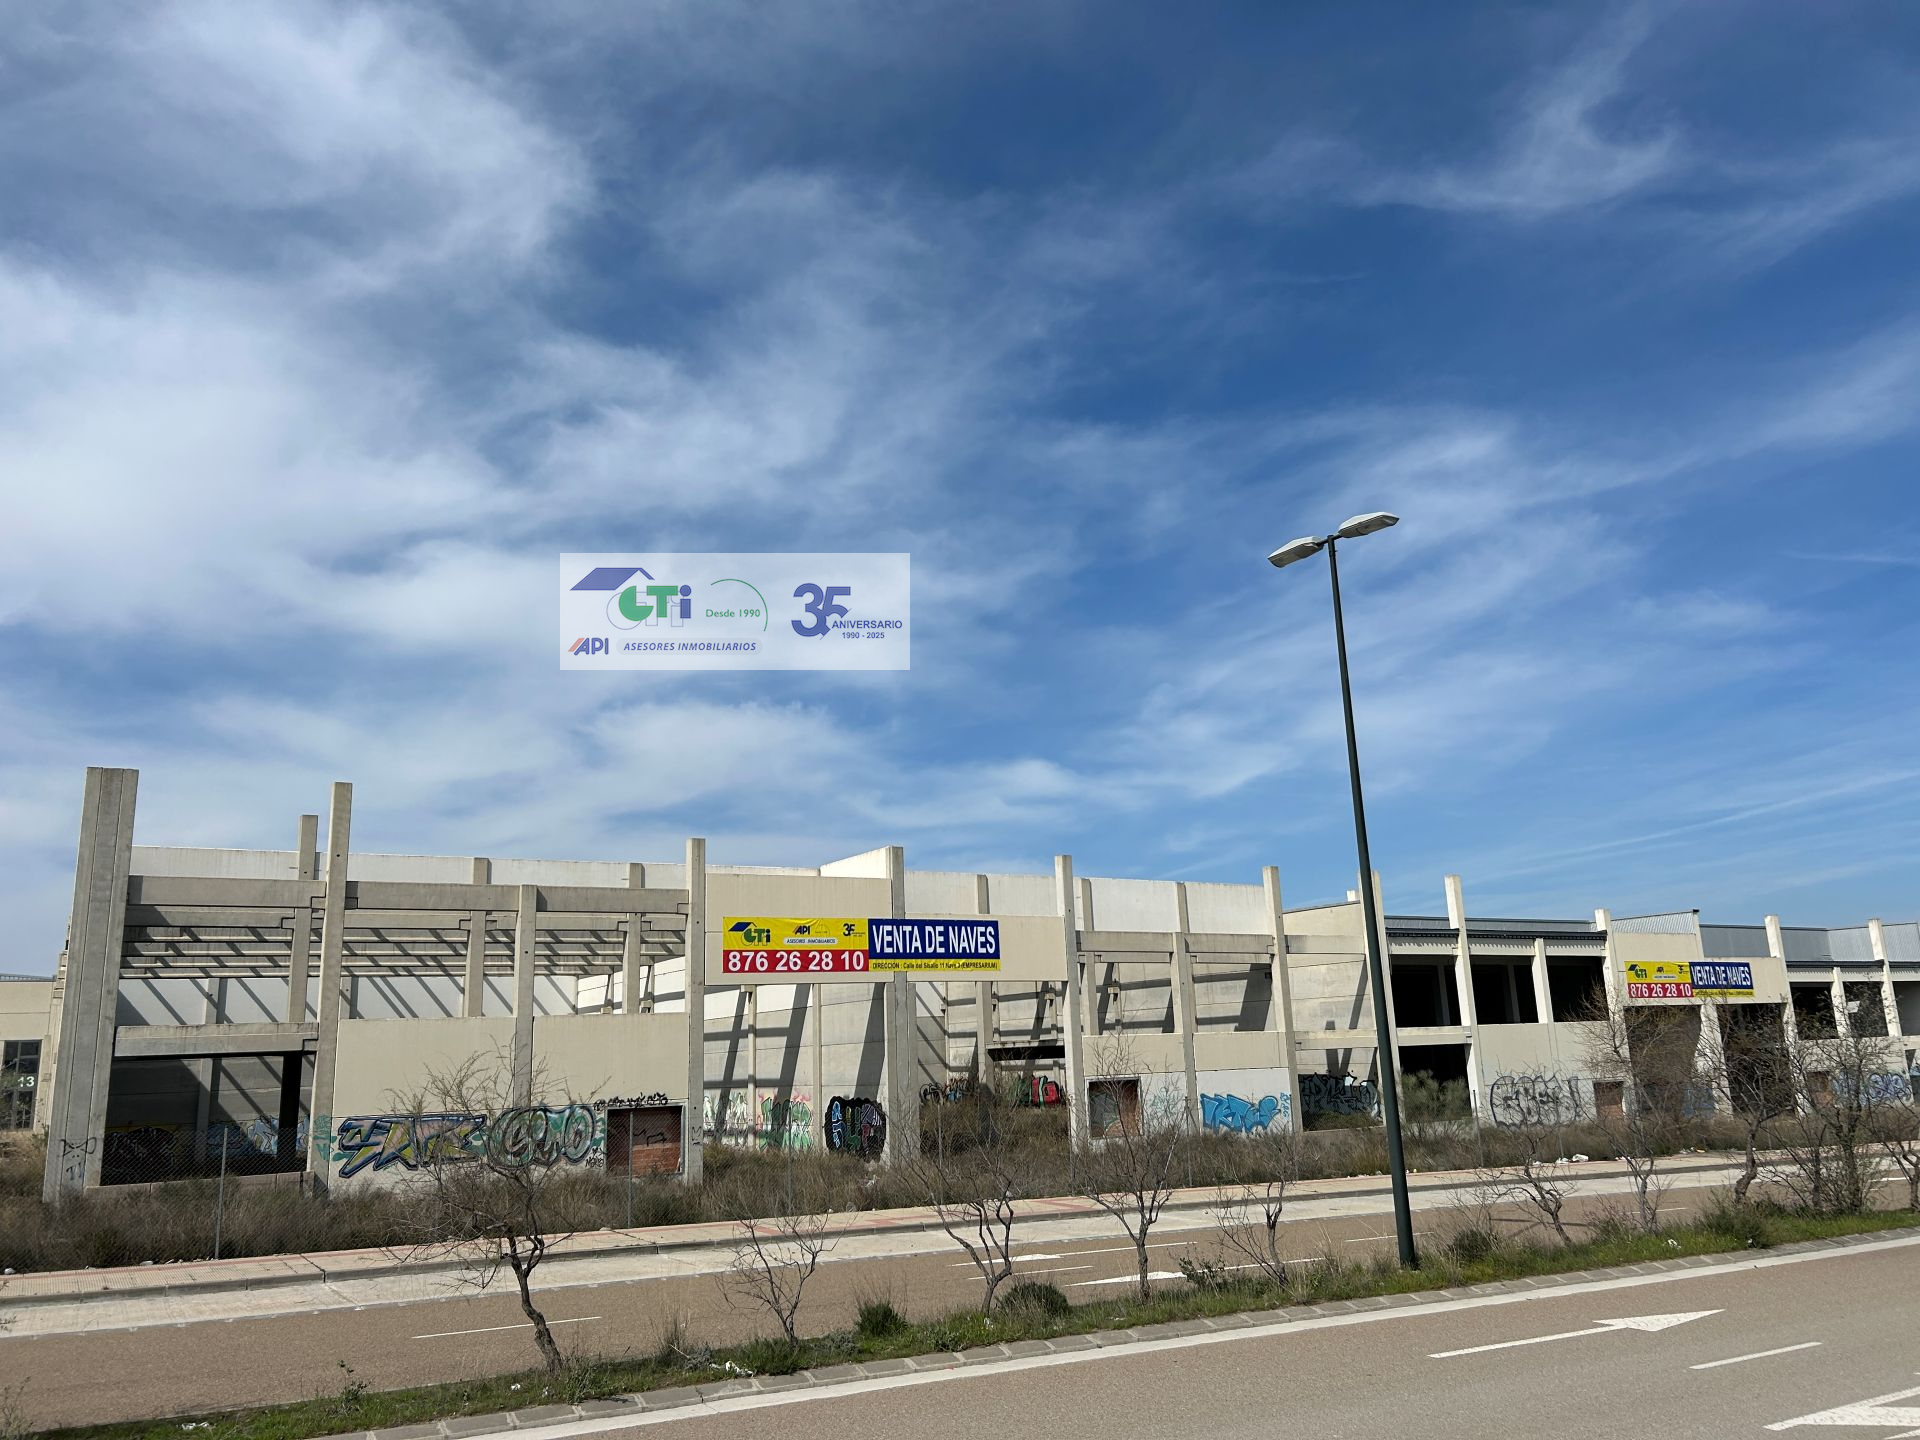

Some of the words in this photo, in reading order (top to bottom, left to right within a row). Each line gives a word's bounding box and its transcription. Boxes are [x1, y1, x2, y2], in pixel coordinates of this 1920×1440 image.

[794, 925, 811, 935] API
[872, 925, 922, 953] VENTA
[925, 925, 945, 953] DE
[949, 926, 996, 954] NAVES
[728, 951, 769, 971] 876
[775, 951, 801, 971] 26
[808, 951, 833, 971] 28
[840, 951, 864, 970] 10
[1690, 966, 1717, 985] VENTA
[1715, 966, 1727, 985] DE
[1726, 966, 1751, 986] NAVES
[1630, 984, 1649, 997] 876
[1650, 984, 1663, 997] 26
[1665, 984, 1678, 996] 28
[1680, 984, 1691, 996] 10
[18, 1076, 35, 1088] 13
